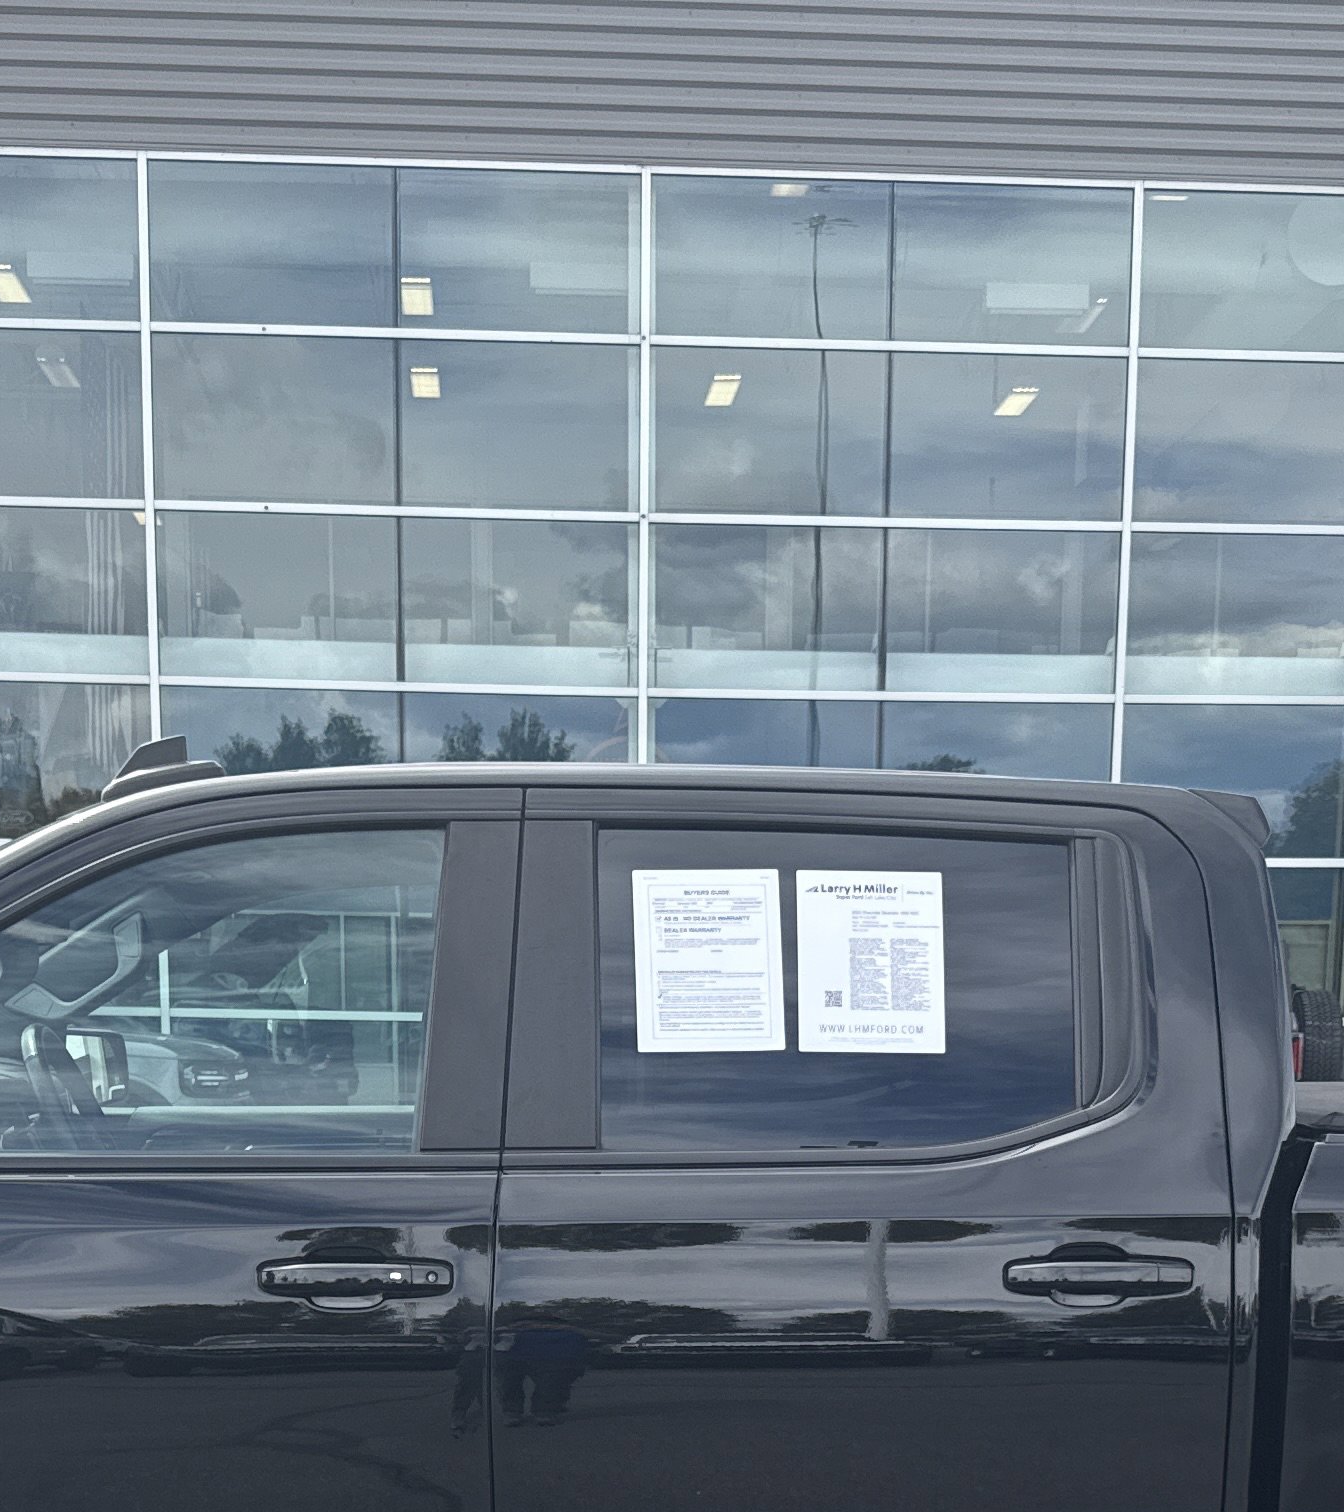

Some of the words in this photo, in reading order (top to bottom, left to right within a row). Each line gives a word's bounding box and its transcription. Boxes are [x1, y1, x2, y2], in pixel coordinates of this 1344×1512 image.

[820, 884, 851, 895] Larry
[853, 884, 862, 893] H
[864, 884, 899, 894] Miller
